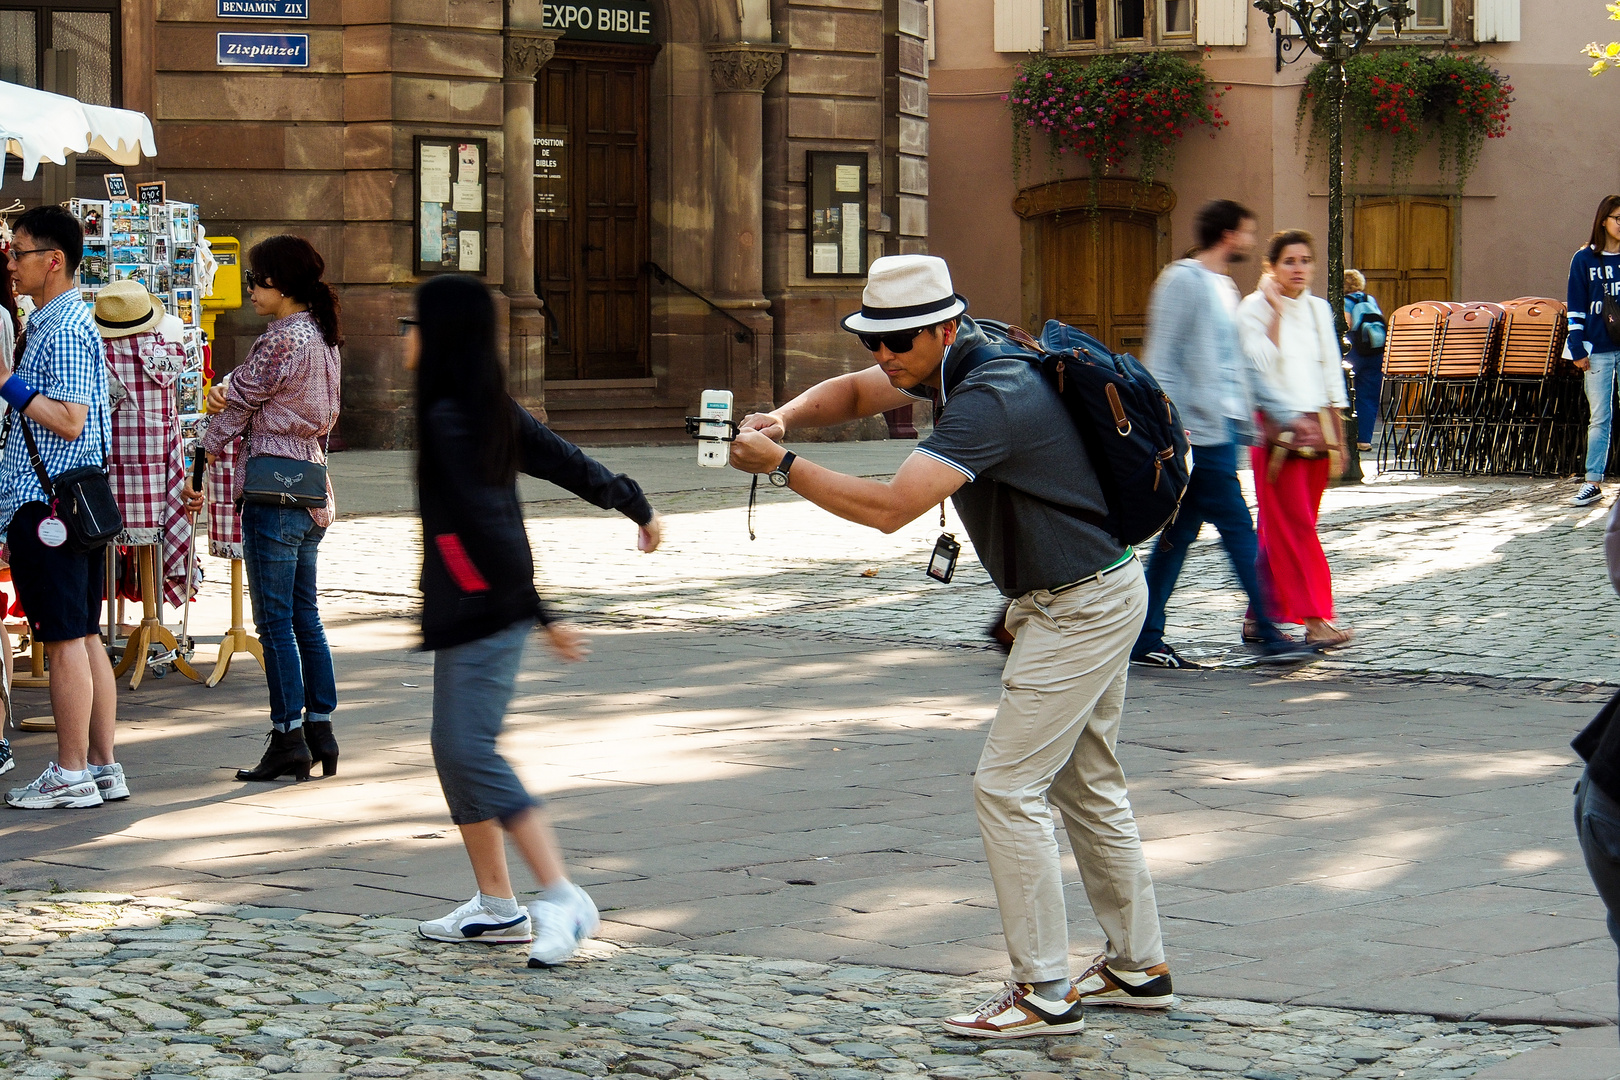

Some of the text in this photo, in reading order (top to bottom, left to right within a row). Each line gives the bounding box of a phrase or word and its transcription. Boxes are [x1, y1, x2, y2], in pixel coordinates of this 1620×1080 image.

[222, 1, 303, 14] BENJAMIN ZIX
[542, 4, 650, 34] EXPO BIBLE
[226, 43, 300, 58] Zixplätzel
[532, 138, 564, 146] XPOSITION
[536, 160, 557, 168] BIBLES
[1589, 265, 1614, 281] FOR
